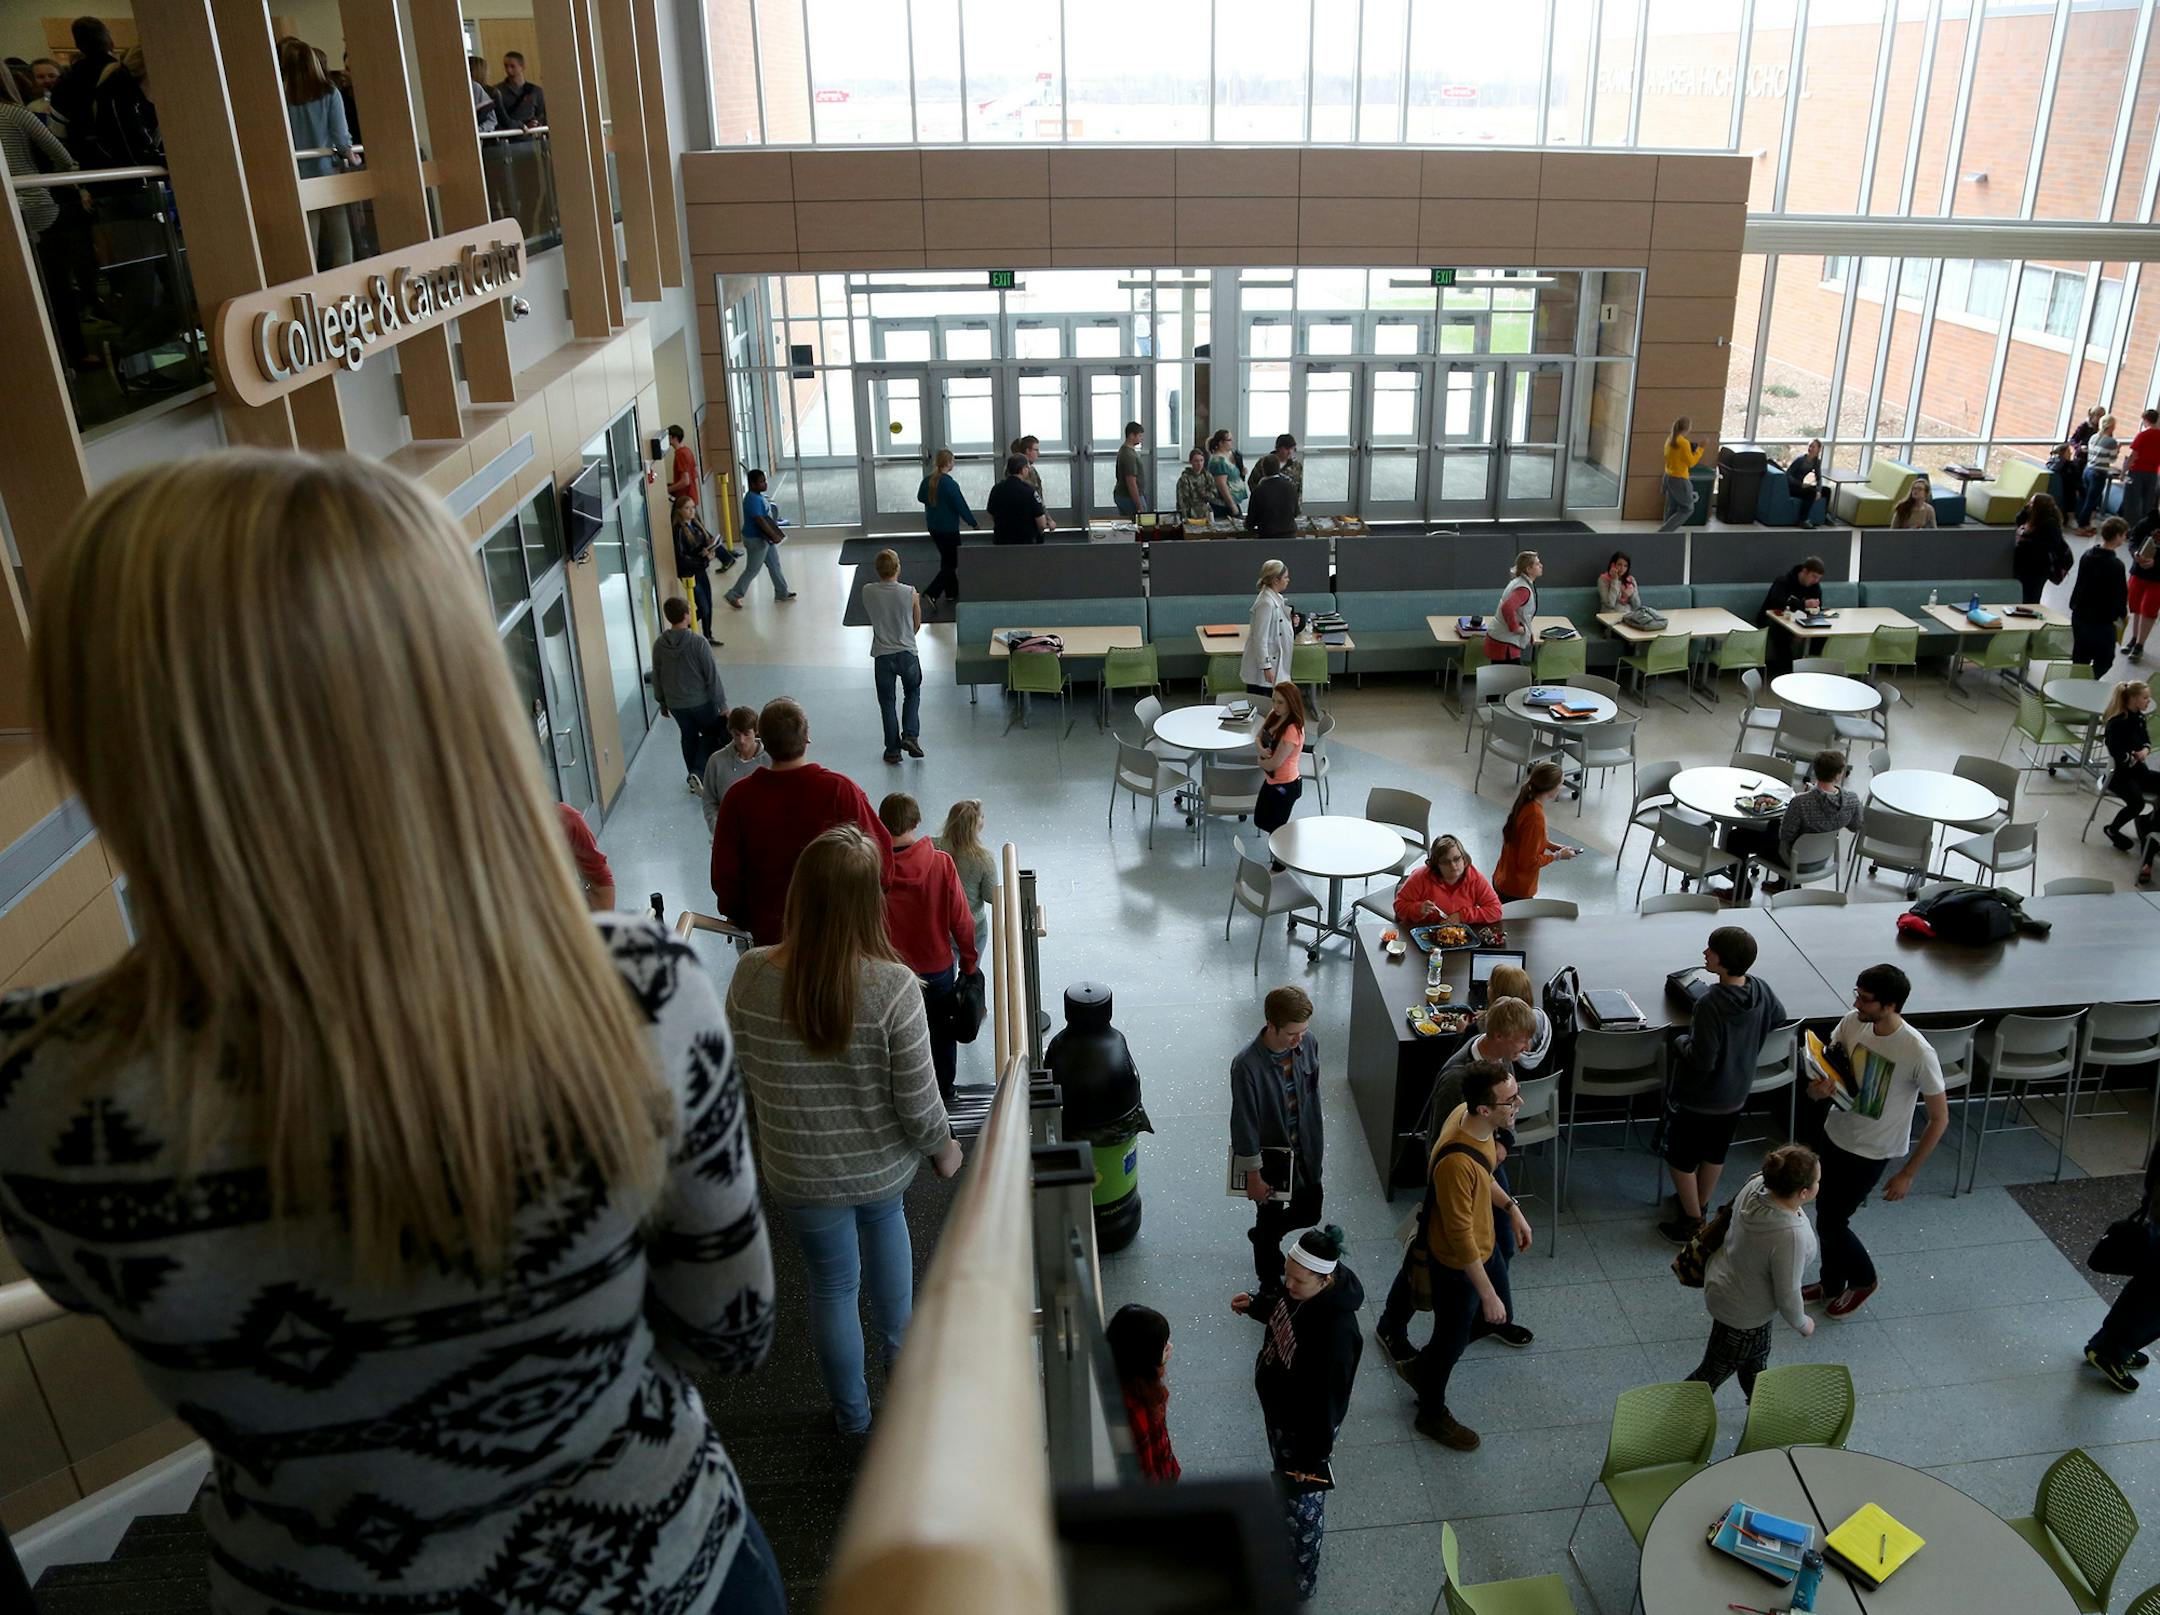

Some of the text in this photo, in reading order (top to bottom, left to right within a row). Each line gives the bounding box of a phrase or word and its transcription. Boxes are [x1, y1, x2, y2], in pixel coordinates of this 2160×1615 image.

[1741, 65, 1813, 98] CHOL
[992, 271, 1012, 287] EXIT
[1435, 270, 1453, 285] EXIT
[252, 240, 520, 383] College & Career Center
